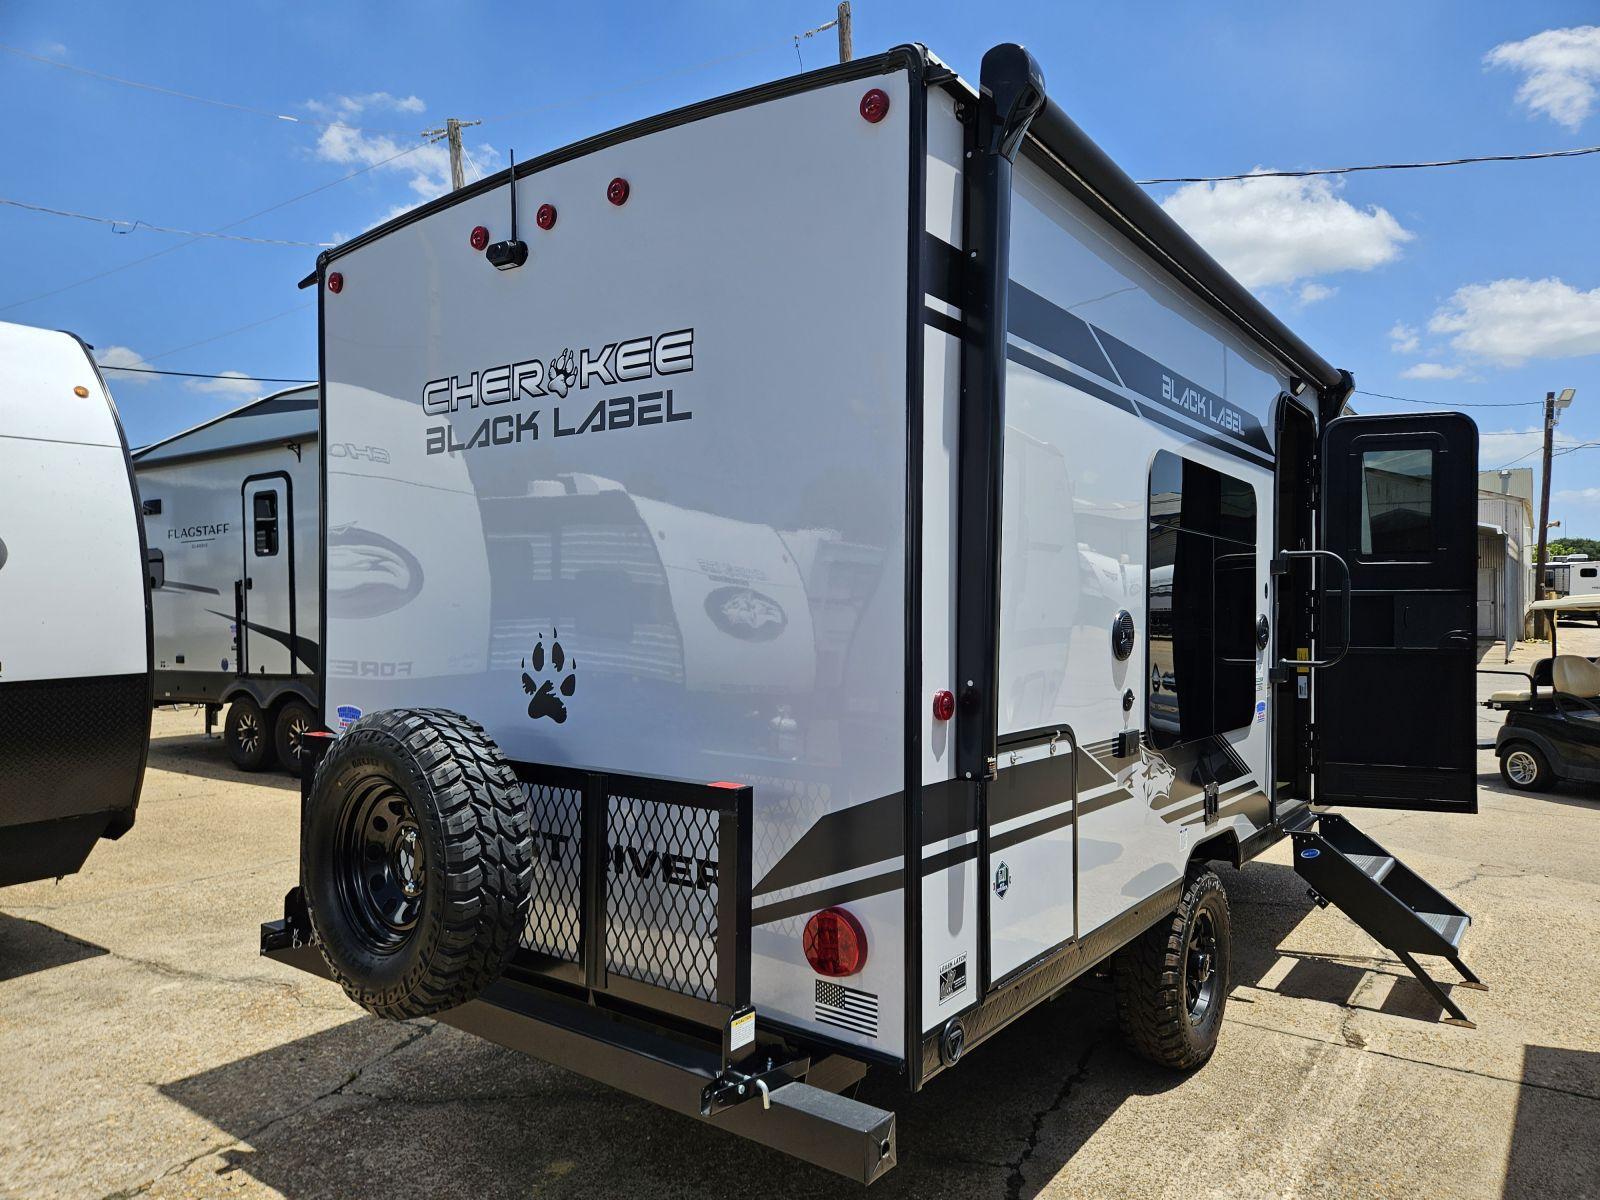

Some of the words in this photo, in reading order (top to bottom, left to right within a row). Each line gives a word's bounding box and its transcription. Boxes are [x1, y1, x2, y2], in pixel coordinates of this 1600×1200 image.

[426, 410, 540, 456] BLACK
[553, 389, 693, 438] LABEL
[1162, 374, 1207, 418] BLACK
[1209, 399, 1246, 437] LABEL
[167, 523, 231, 540] FLAGSTAFF
